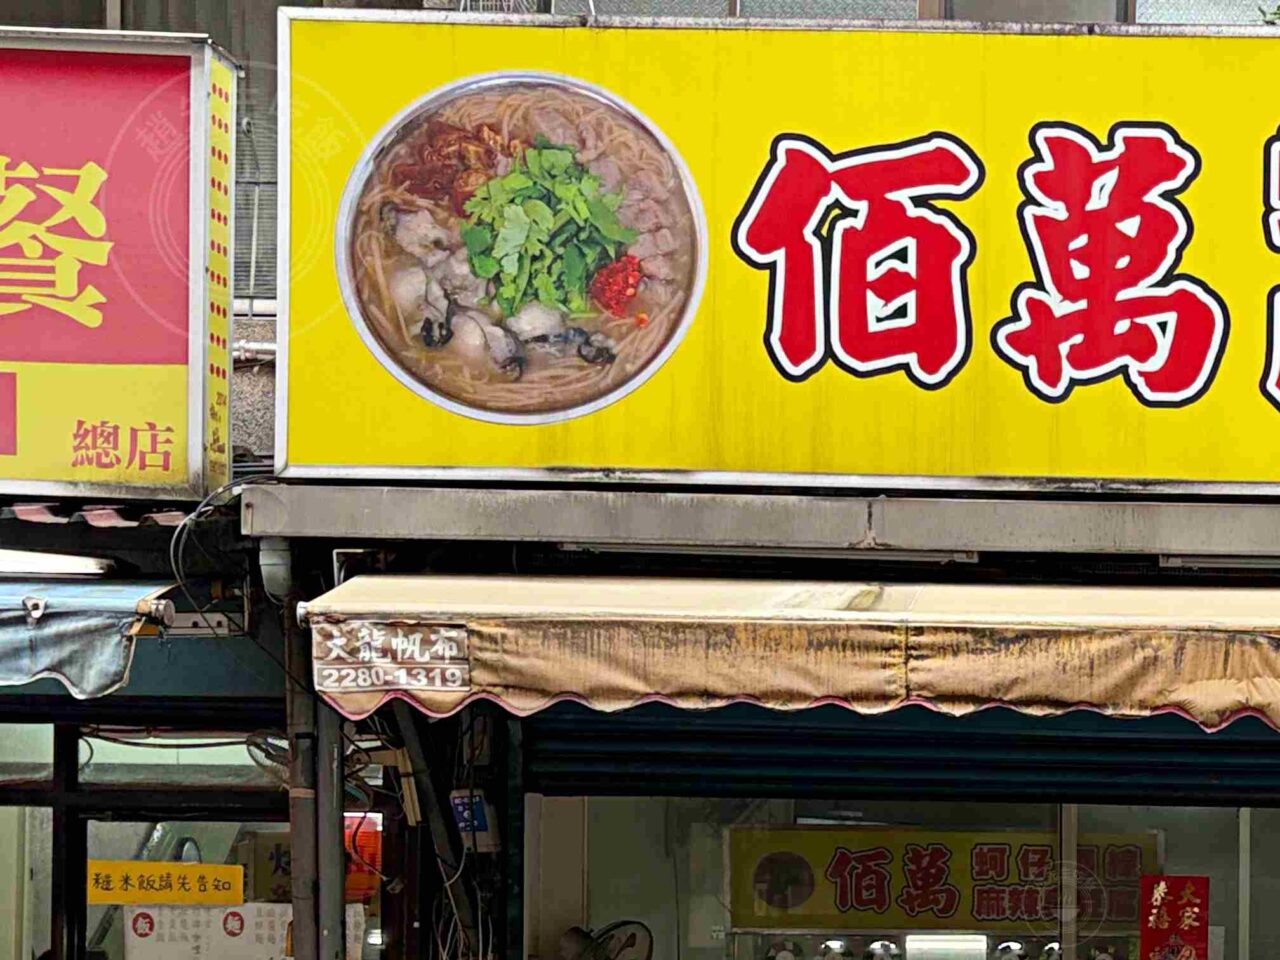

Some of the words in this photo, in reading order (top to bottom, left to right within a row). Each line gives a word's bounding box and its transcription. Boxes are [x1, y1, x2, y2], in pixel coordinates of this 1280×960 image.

[738, 124, 1229, 405] 佰萬
[71, 420, 175, 473] 總店
[322, 668, 463, 688] 2280-1319
[825, 845, 961, 921] 佰萬
